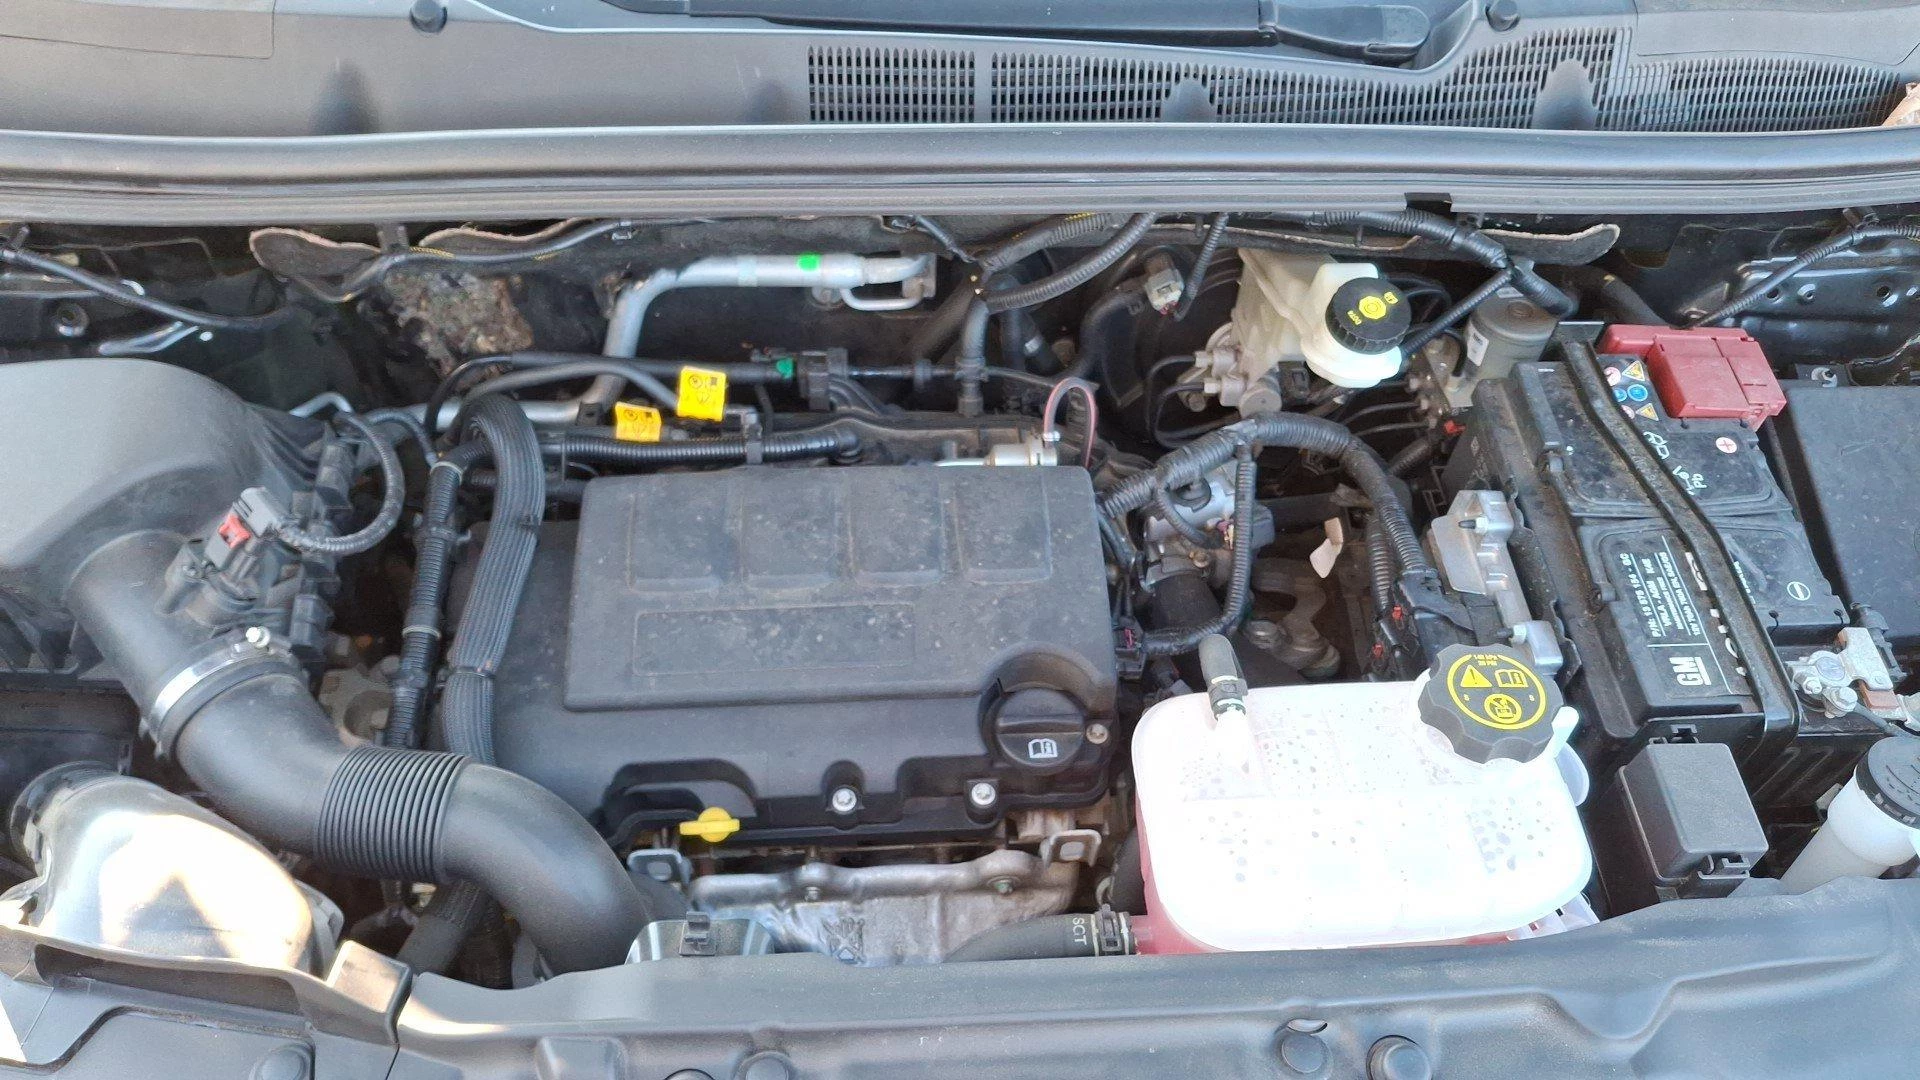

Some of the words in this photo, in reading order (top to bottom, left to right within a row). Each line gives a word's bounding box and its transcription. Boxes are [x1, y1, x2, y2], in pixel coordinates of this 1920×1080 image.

[1691, 473, 1707, 489] Pb
[1669, 656, 1705, 686] GM
[1072, 917, 1087, 946] SCT
